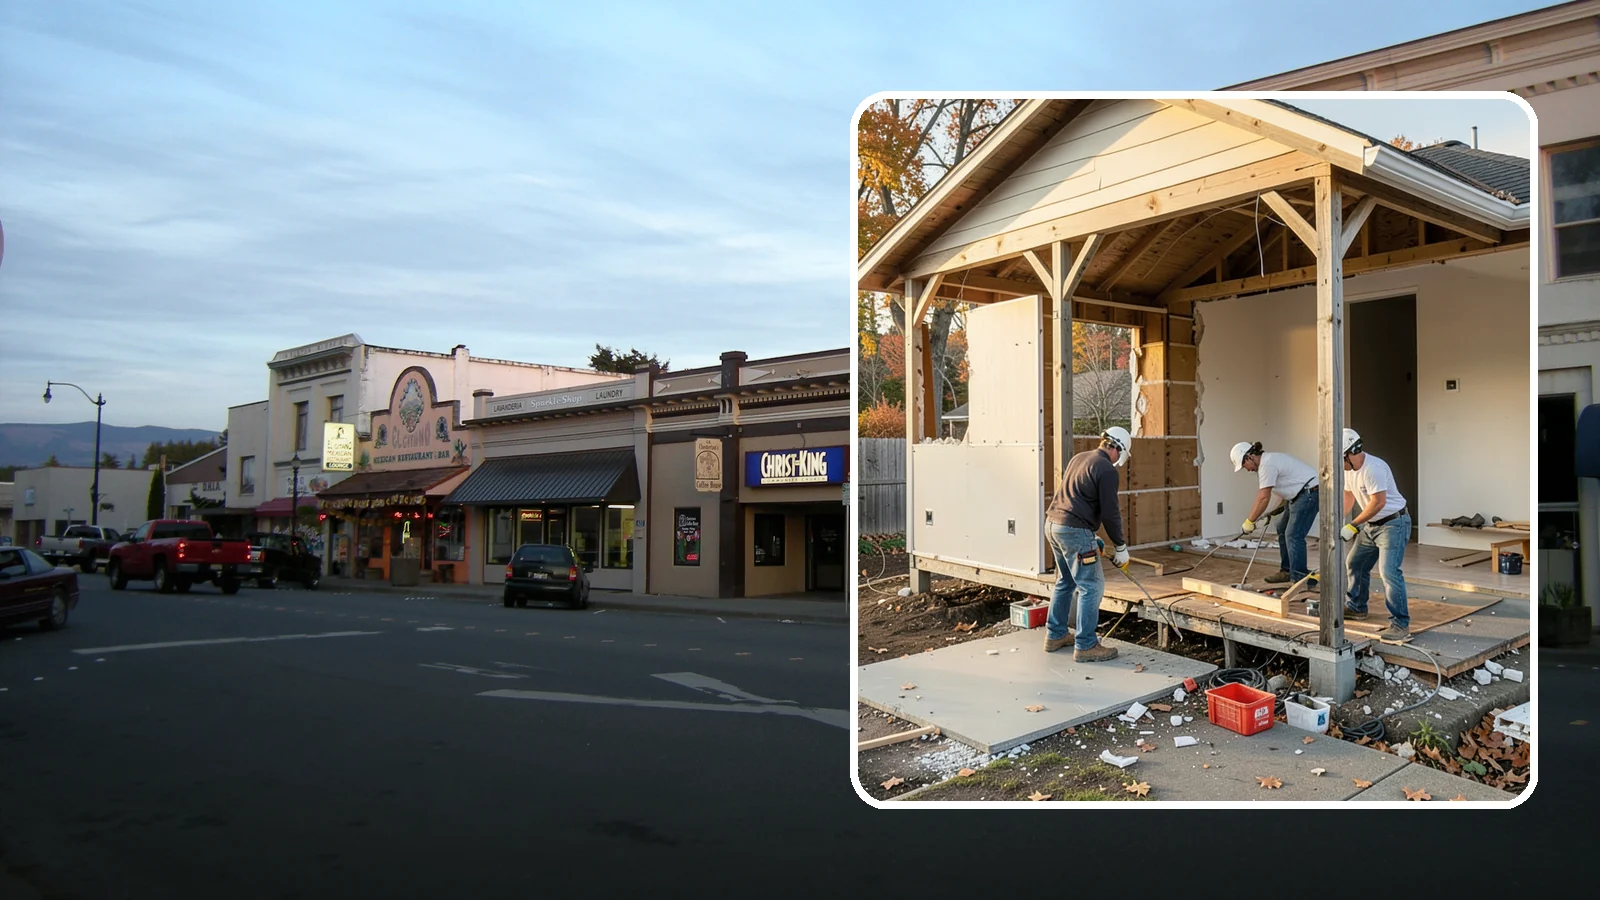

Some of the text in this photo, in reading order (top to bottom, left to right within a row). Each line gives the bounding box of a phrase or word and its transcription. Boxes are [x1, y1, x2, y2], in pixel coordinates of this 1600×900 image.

[595, 389, 623, 400] LAUNDRY
[493, 402, 523, 412] LAVANDERIA
[530, 394, 583, 409] Sparkle Shop
[373, 455, 396, 464] MEXICAN
[397, 451, 433, 463] RESTAURANT
[438, 449, 450, 459] BAR
[760, 450, 827, 478] CHRIST KING
[696, 480, 709, 488] Coffee
